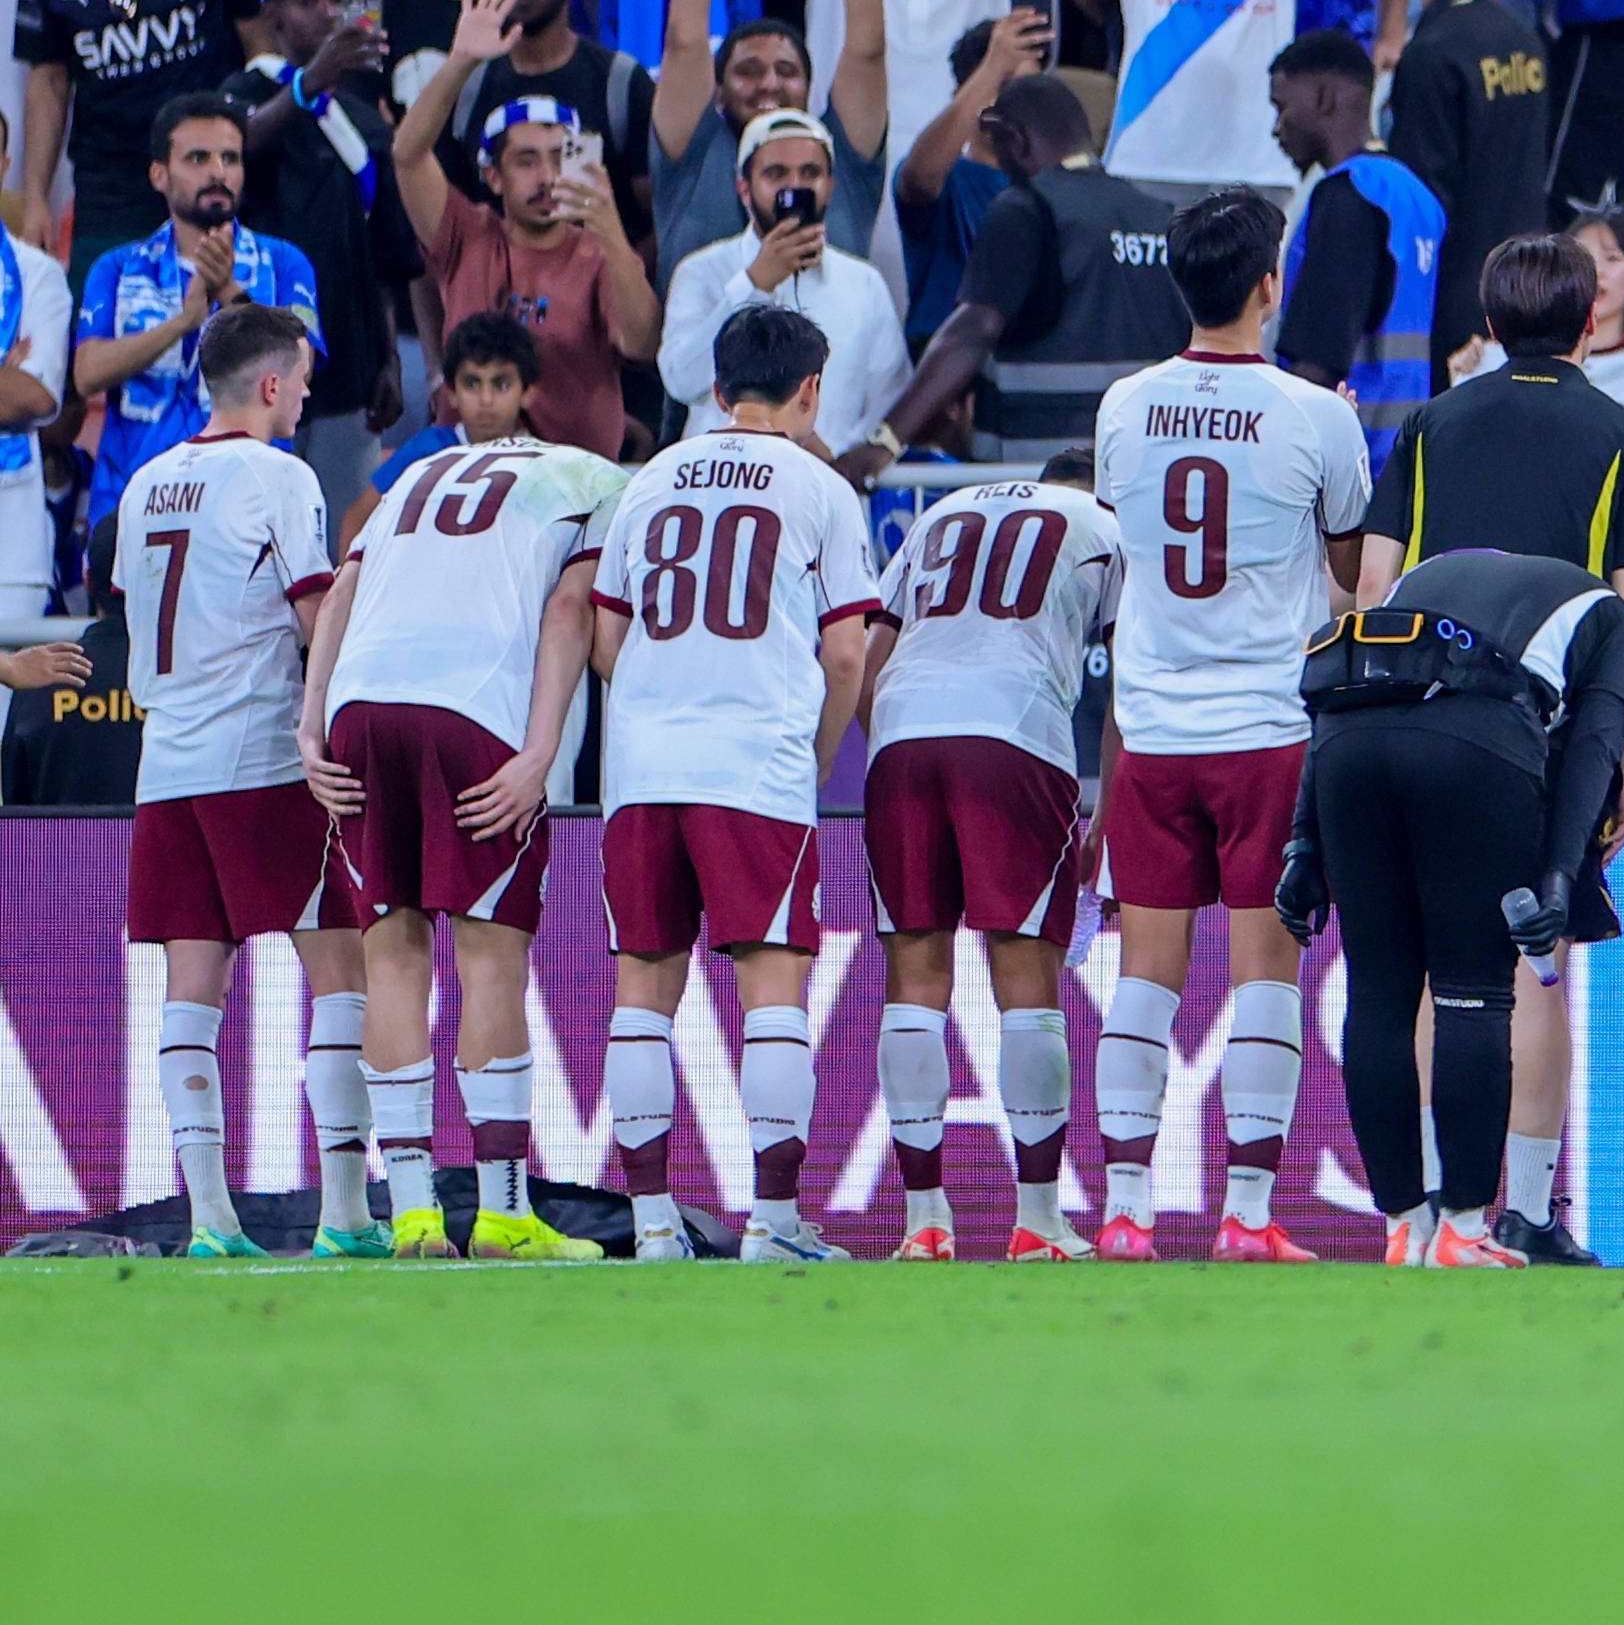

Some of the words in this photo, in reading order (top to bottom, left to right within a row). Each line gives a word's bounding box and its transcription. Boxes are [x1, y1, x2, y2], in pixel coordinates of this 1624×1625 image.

[73, 10, 206, 69] SAVVY
[1145, 405, 1264, 444] INHYEOK
[144, 481, 206, 517] ASANI
[394, 451, 546, 537] 15
[673, 462, 774, 492] SEJONG
[1164, 455, 1229, 600] 9
[642, 504, 782, 642] 80
[915, 510, 1067, 620] 90
[145, 528, 191, 676] 7
[54, 689, 147, 723] Poli
